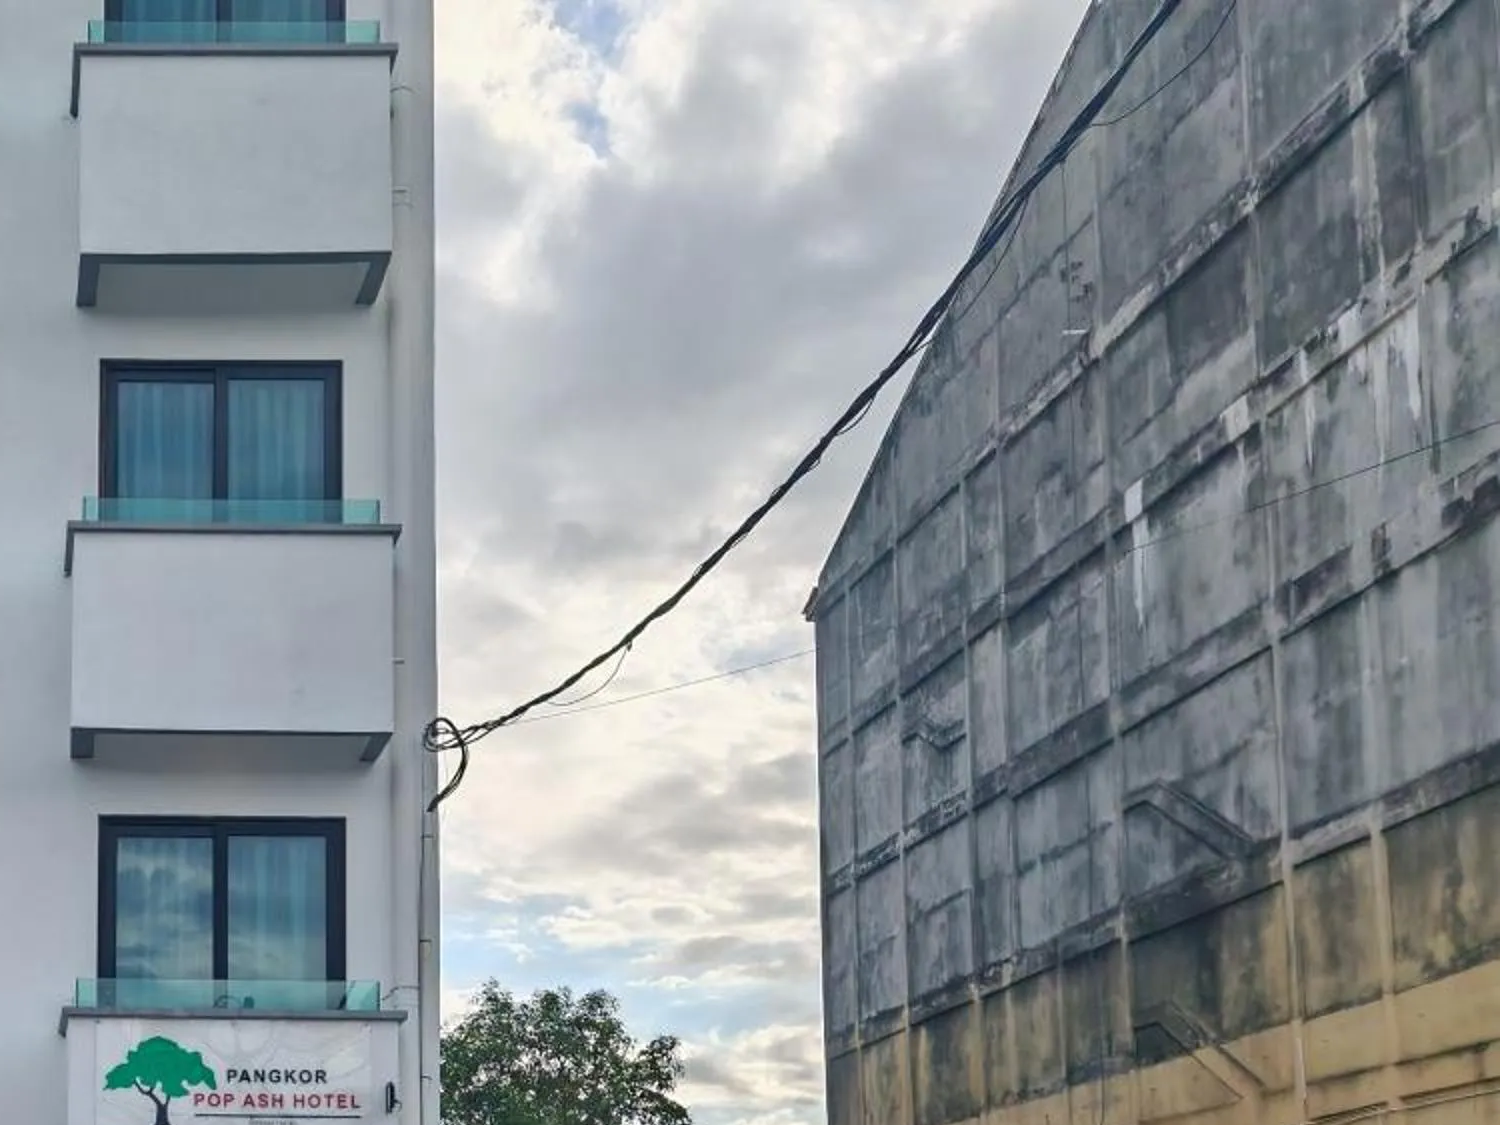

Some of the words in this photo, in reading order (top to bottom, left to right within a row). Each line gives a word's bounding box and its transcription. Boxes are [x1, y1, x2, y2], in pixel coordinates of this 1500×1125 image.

[226, 1070, 328, 1084] PANGKOR
[193, 1092, 235, 1108] POP
[243, 1093, 284, 1109] ASH
[293, 1094, 362, 1109] HOTEL
